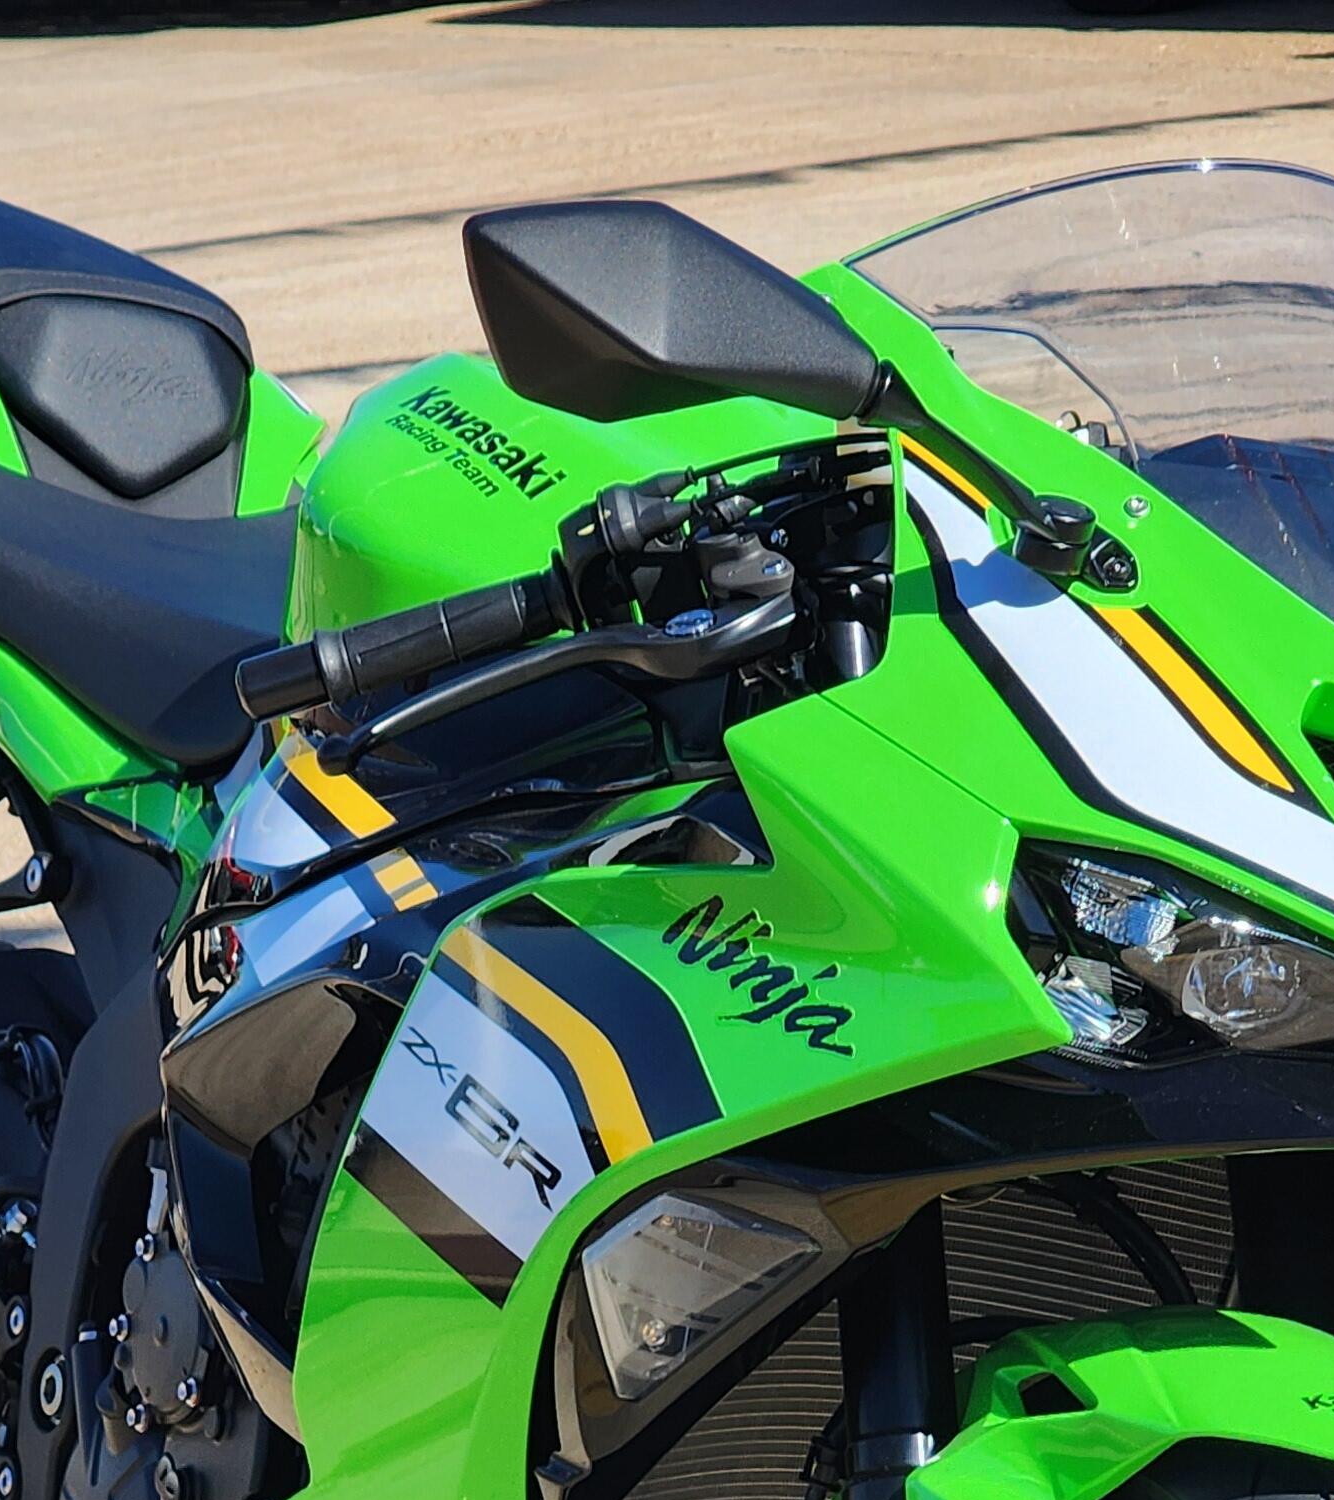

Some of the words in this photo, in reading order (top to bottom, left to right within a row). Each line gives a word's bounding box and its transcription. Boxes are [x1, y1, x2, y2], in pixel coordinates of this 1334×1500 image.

[385, 413, 450, 454] Racing
[444, 447, 500, 498] Team
[399, 386, 566, 500] Kawasaki
[661, 895, 855, 1057] Ninja
